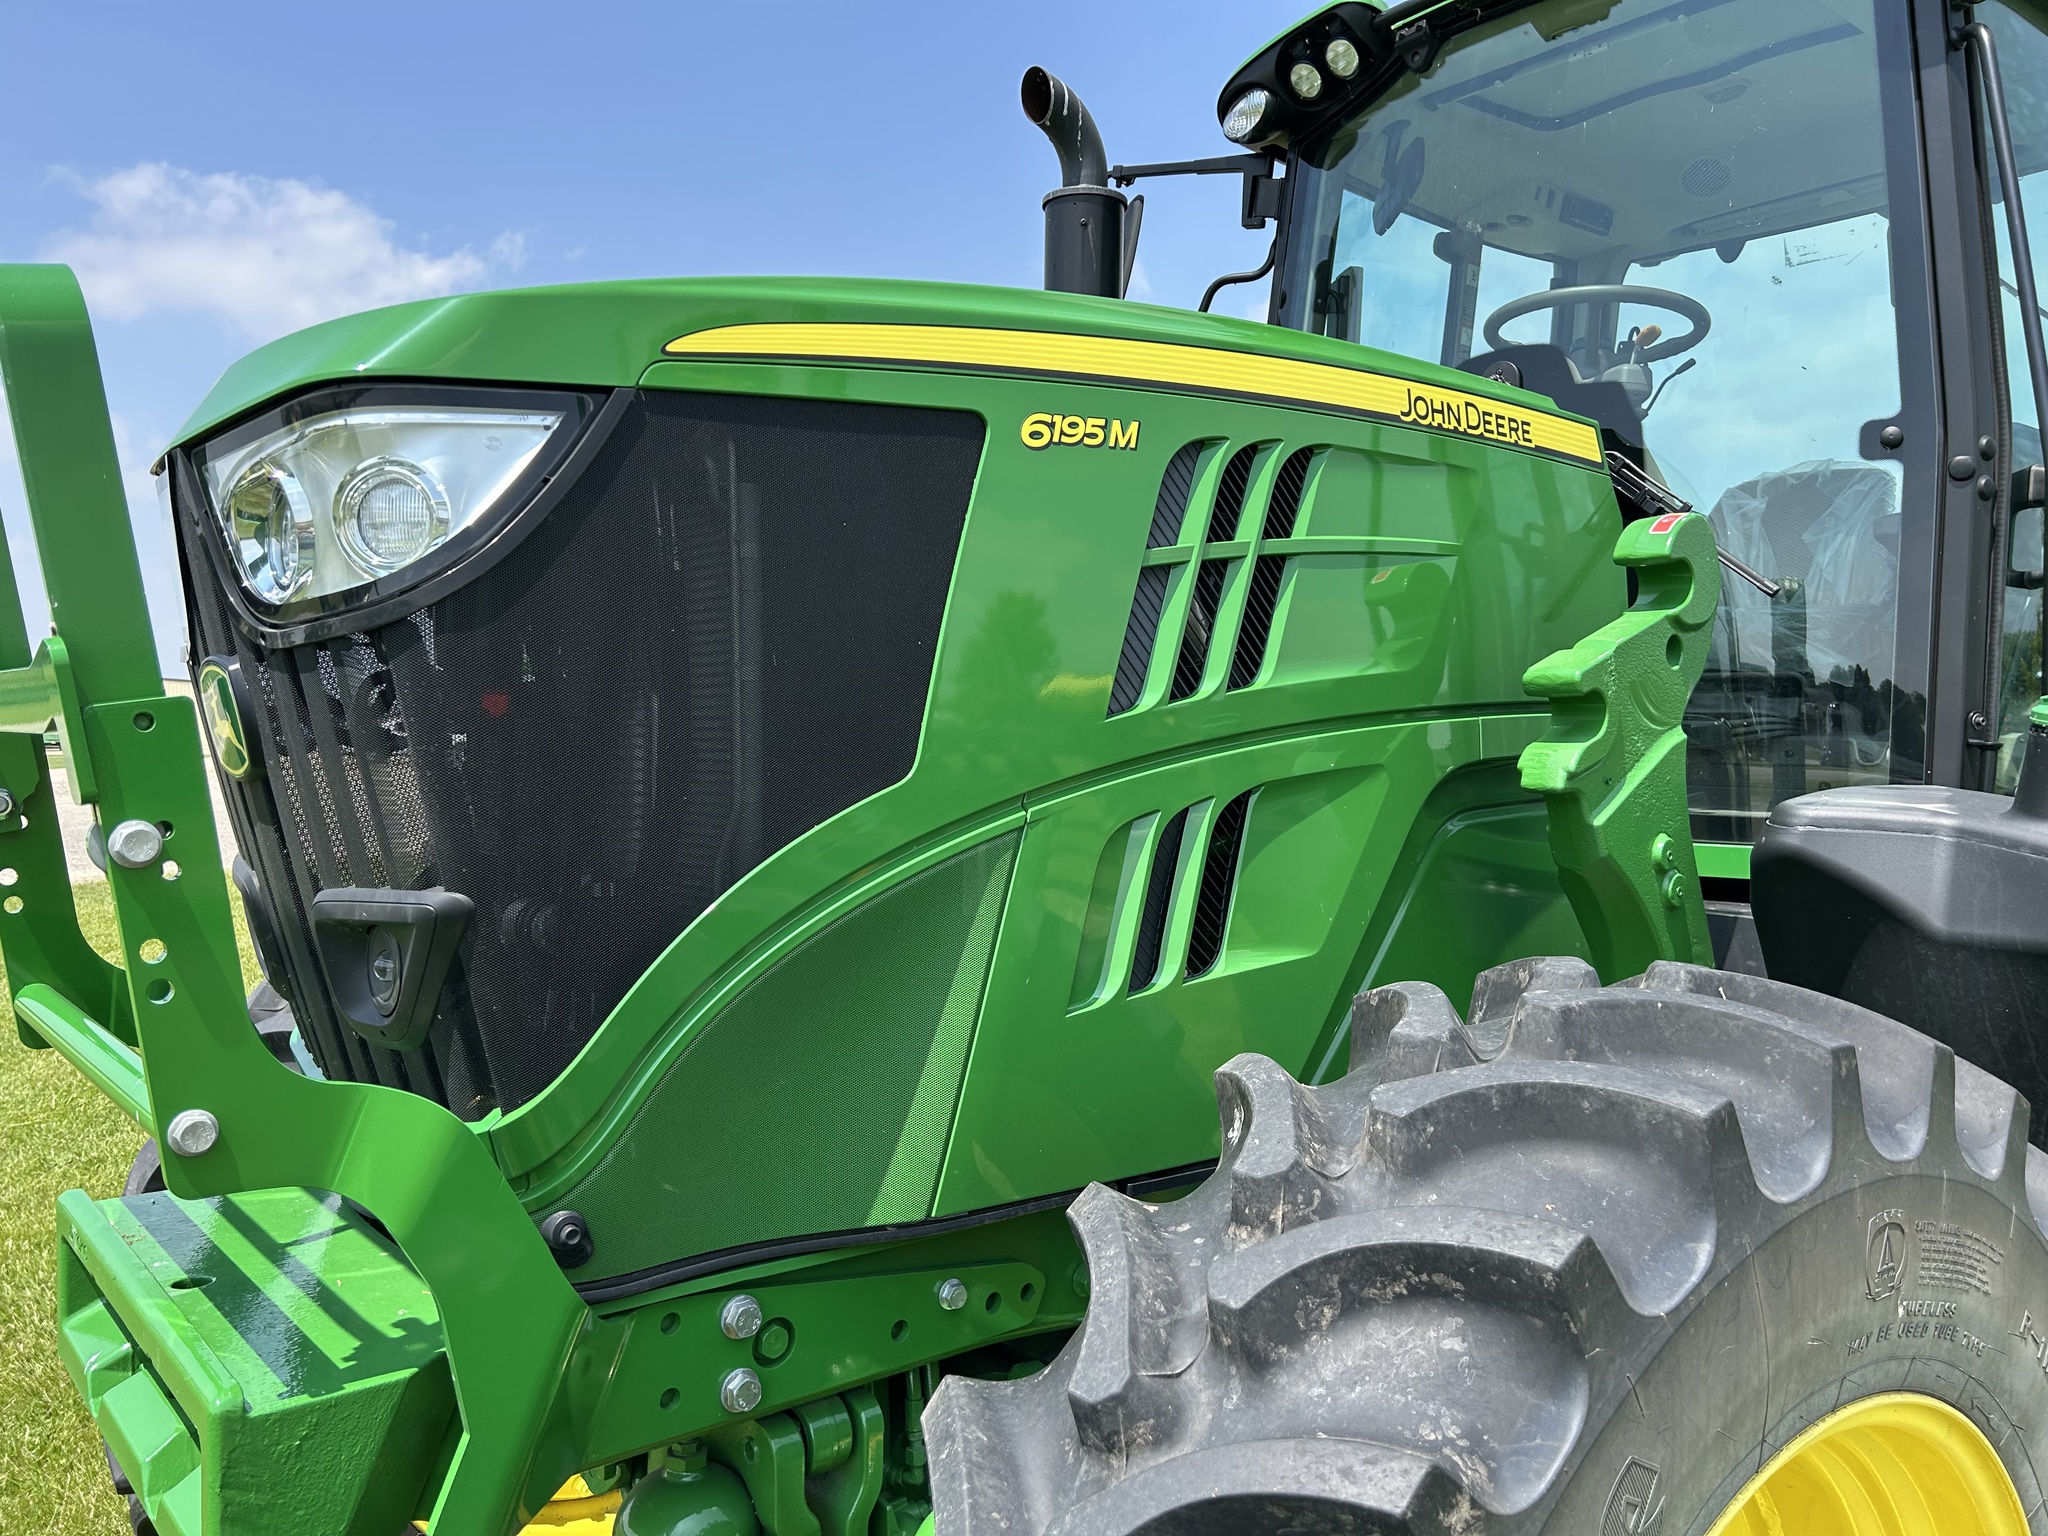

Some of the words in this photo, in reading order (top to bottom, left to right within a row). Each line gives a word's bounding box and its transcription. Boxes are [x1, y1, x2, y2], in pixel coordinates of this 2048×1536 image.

[1901, 1300, 1957, 1318] TUBELESS
[1847, 1331, 1873, 1356] MAY
[1876, 1322, 1894, 1342] BE
[1898, 1321, 1929, 1338] USED
[1932, 1322, 1960, 1341] TUBE
[1960, 1330, 1987, 1357] TYPE
